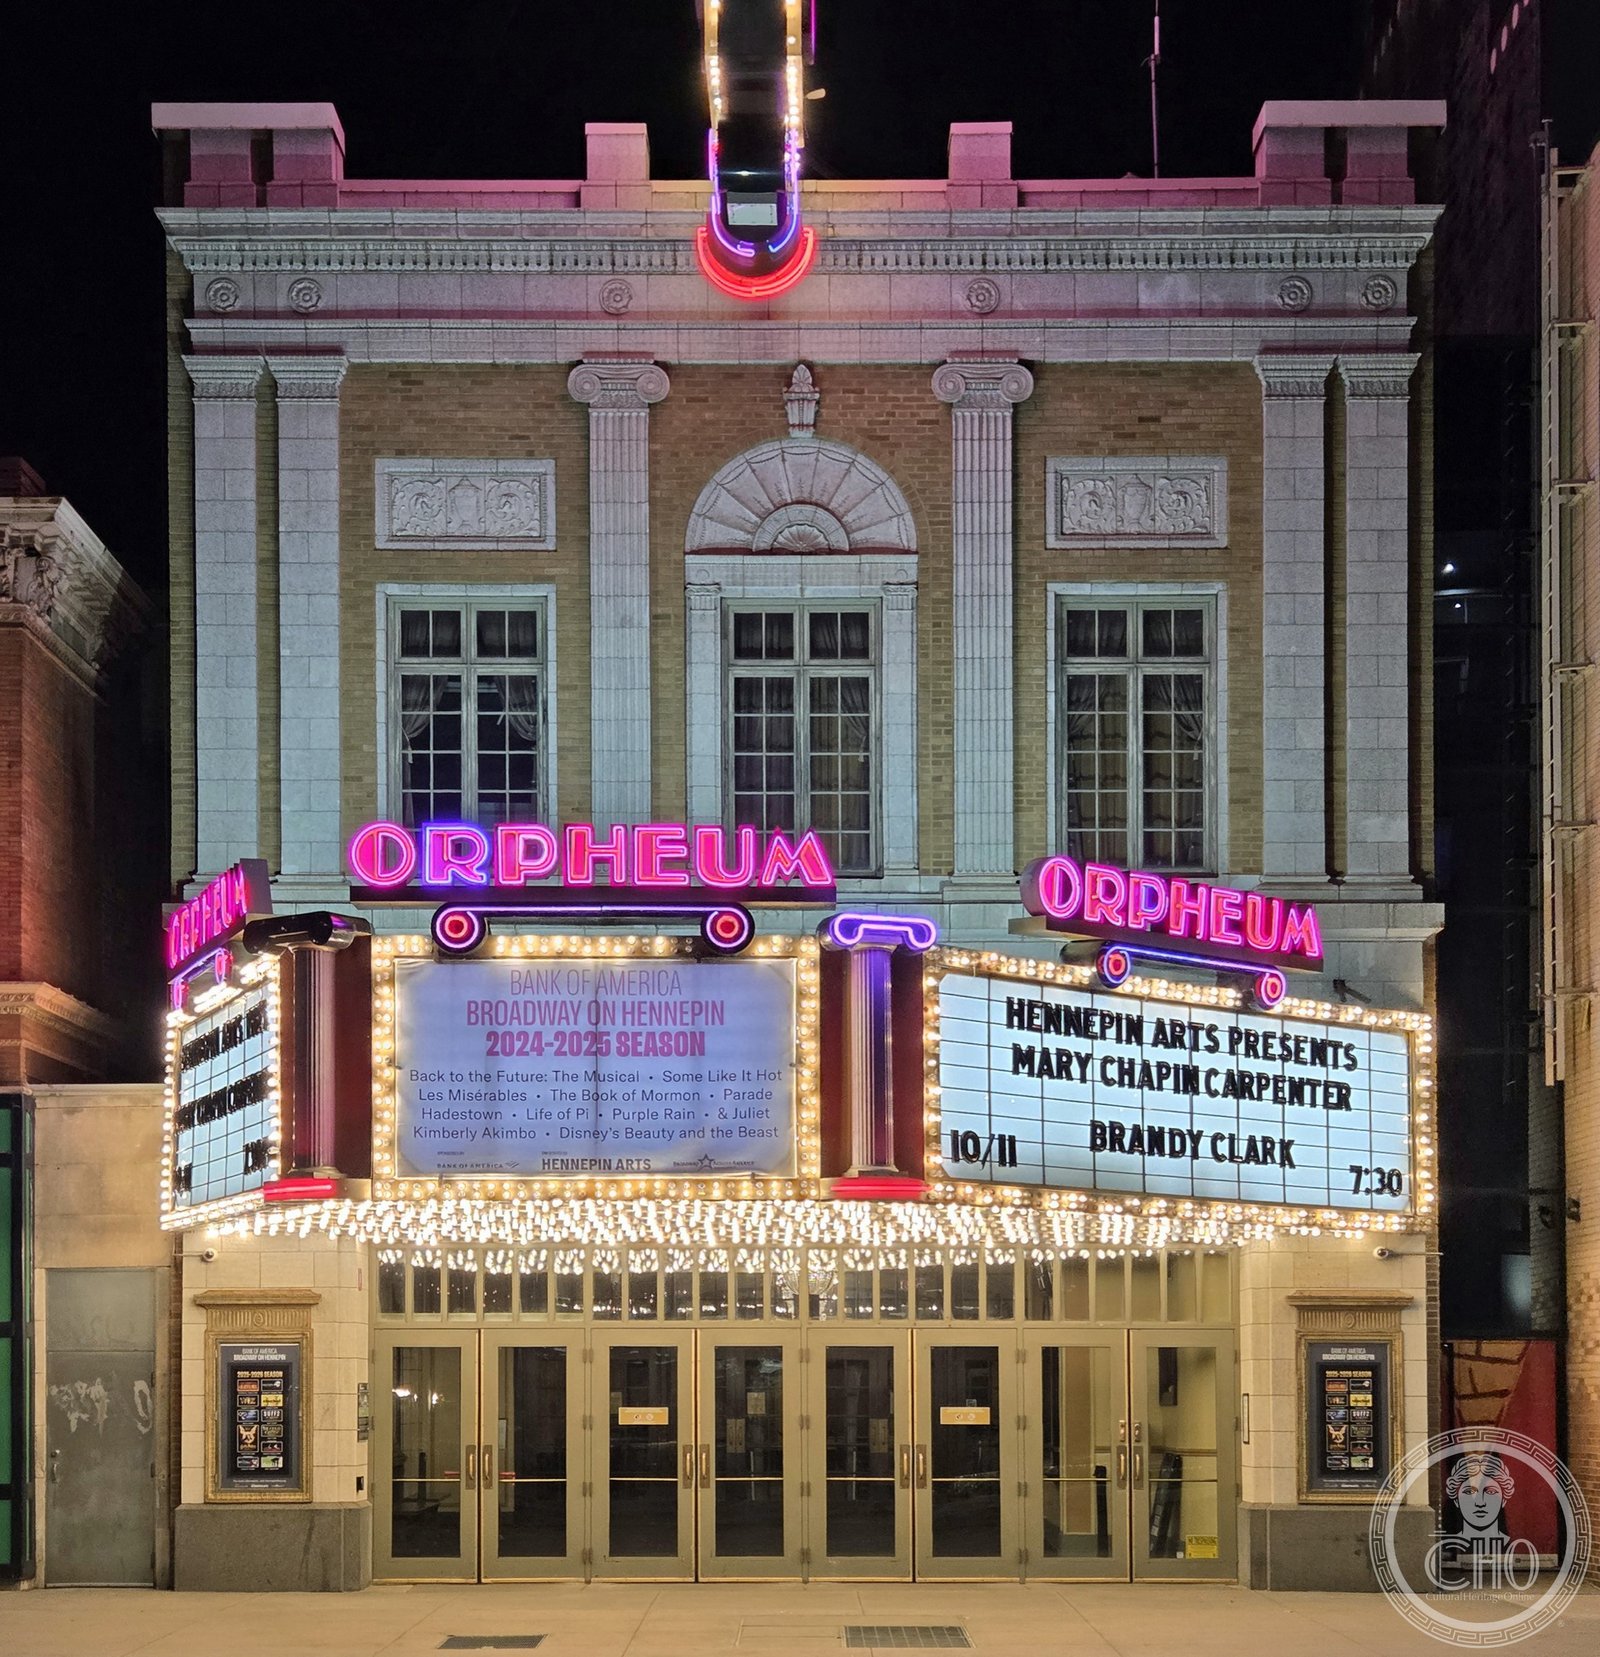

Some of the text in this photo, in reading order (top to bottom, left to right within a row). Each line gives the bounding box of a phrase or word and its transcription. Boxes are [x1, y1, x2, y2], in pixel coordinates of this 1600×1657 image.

[350, 821, 833, 887] ORPHEUM
[1039, 855, 1324, 959] ORPHEUM
[510, 969, 682, 996] BANK OF AMERICA
[467, 1000, 724, 1026] BROADWAY ON HENNEPIN
[485, 1031, 705, 1057] 2024-2025 SEASON
[1006, 996, 1358, 1072] HENNEPIN ARTS PRESENTS
[410, 1069, 782, 1083] Back to the Future: The Musical Some Like It Hot
[1012, 1044, 1351, 1111] MARY CHAPIN CARPENTER
[419, 1088, 773, 1101] Les Misérables The Book of Mormon Parade
[421, 1107, 770, 1122] Hadestown Life of Pi Purple Rain & Juliet
[413, 1126, 477, 1141] Kimberly
[481, 1127, 536, 1139] Akimbo
[625, 1127, 675, 1141] Beauty
[679, 1127, 705, 1139] and
[711, 1127, 733, 1138] the
[738, 1126, 779, 1138] Beast
[1089, 1120, 1295, 1169] BRANDY CLARK
[950, 1129, 1017, 1169] 10/11
[542, 1158, 651, 1170] HENNEPIN ARTS
[1349, 1165, 1403, 1197] 7:30
